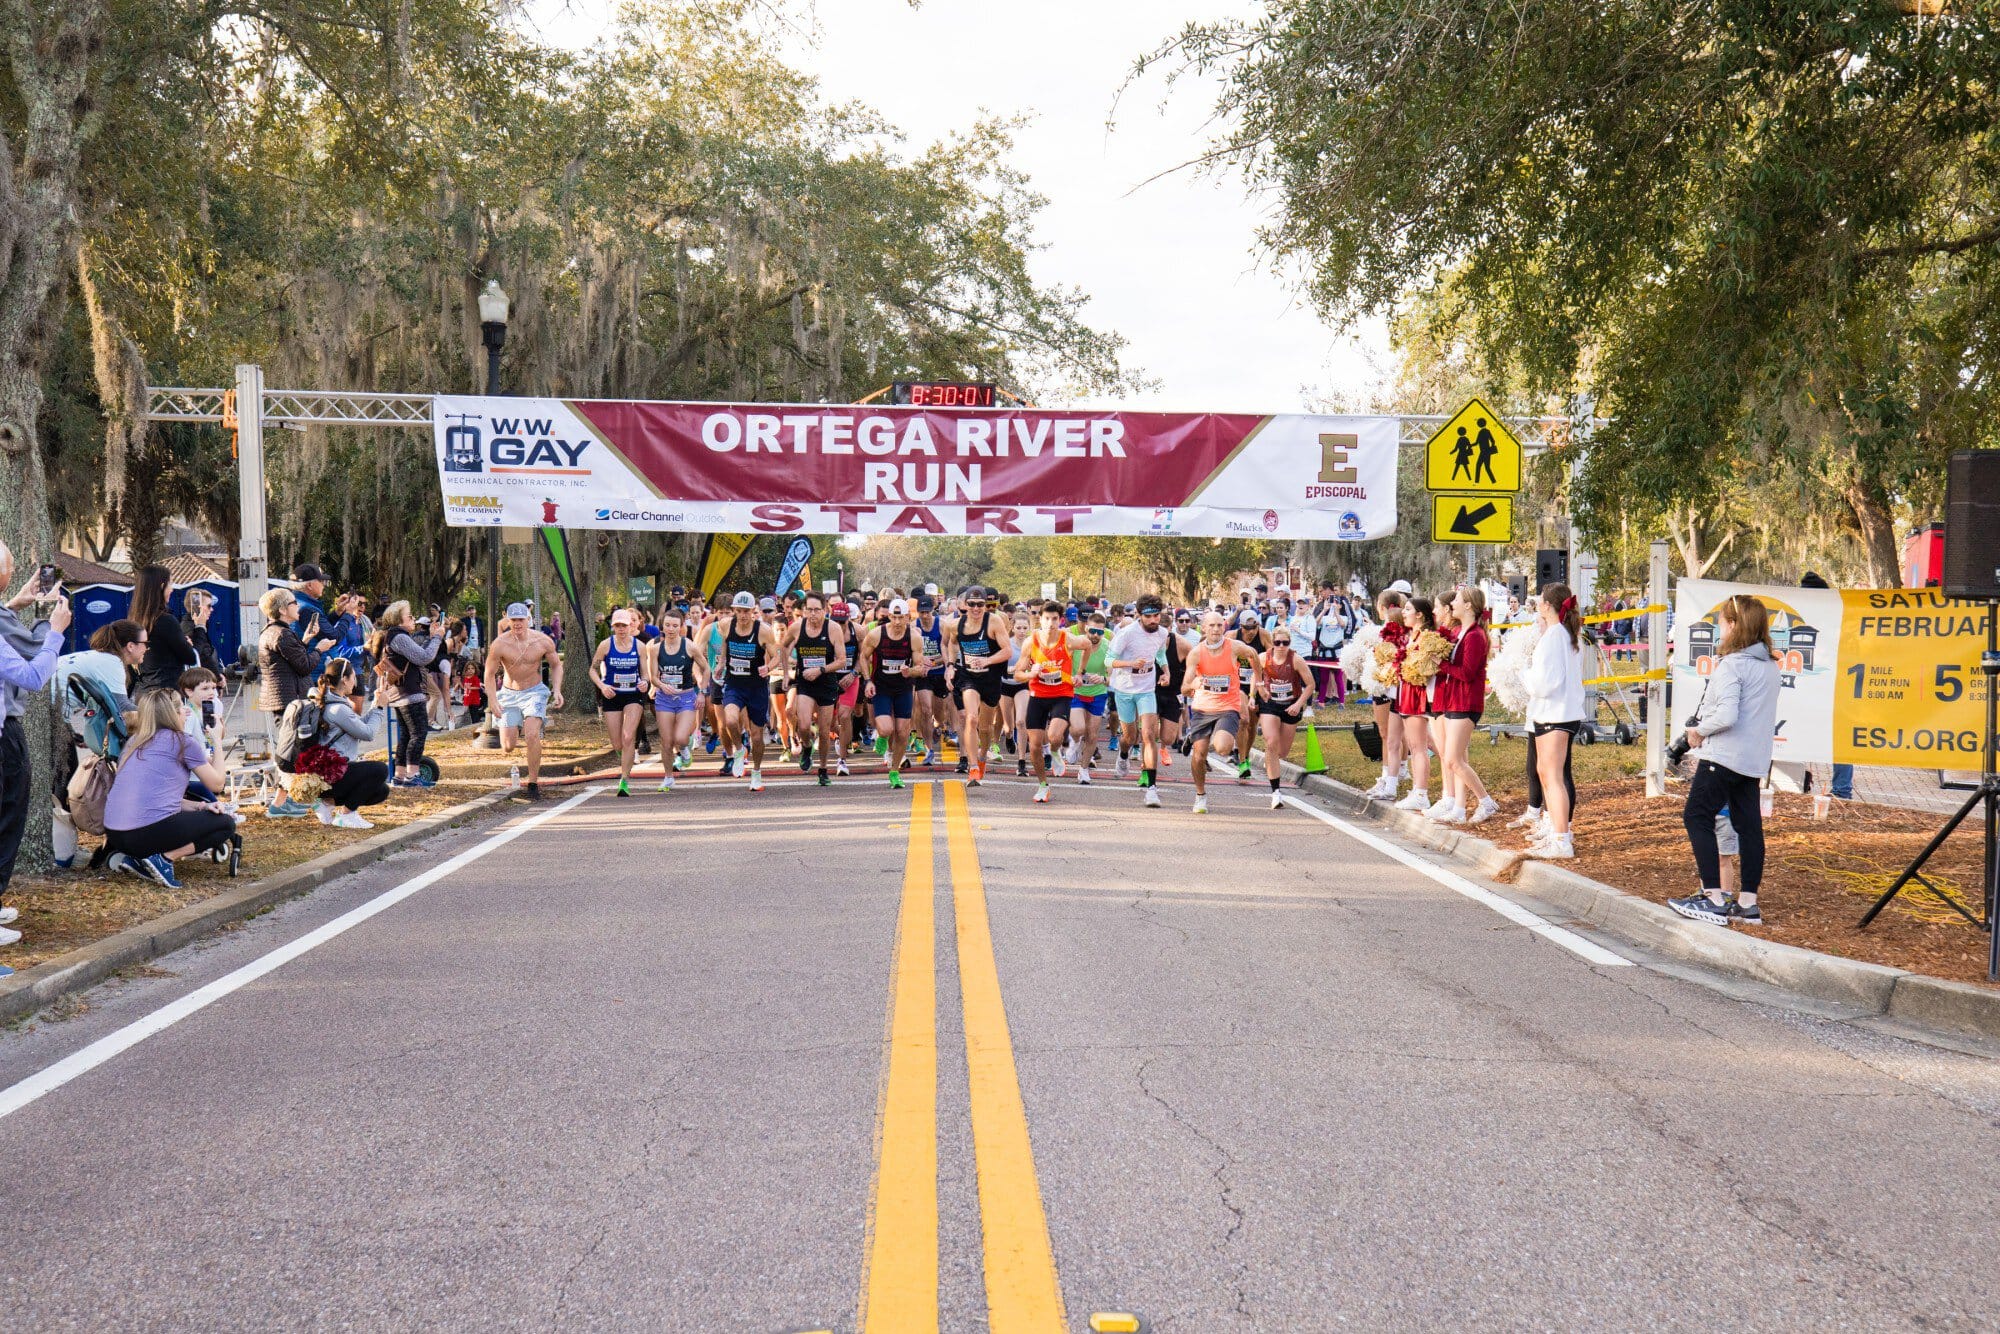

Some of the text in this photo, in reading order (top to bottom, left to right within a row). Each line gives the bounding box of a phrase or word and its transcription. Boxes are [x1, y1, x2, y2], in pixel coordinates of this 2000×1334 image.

[490, 417, 556, 436] W.W.
[701, 413, 1127, 459] ORTEGA RIVER
[489, 437, 592, 467] GAY
[447, 477, 588, 488] MECHANICAL CONTRACTOR, INC.
[864, 461, 982, 501] RUN
[1305, 485, 1367, 500] EPISCOPAL
[611, 510, 640, 521] Clear
[641, 511, 684, 522] Channel
[749, 504, 1093, 534] START
[1870, 666, 1893, 675] MILE
[1847, 663, 1866, 699] 1
[1869, 678, 1910, 688] FUN RUN
[1934, 664, 1963, 703] 5
[1867, 691, 1904, 700] 8:00 AM
